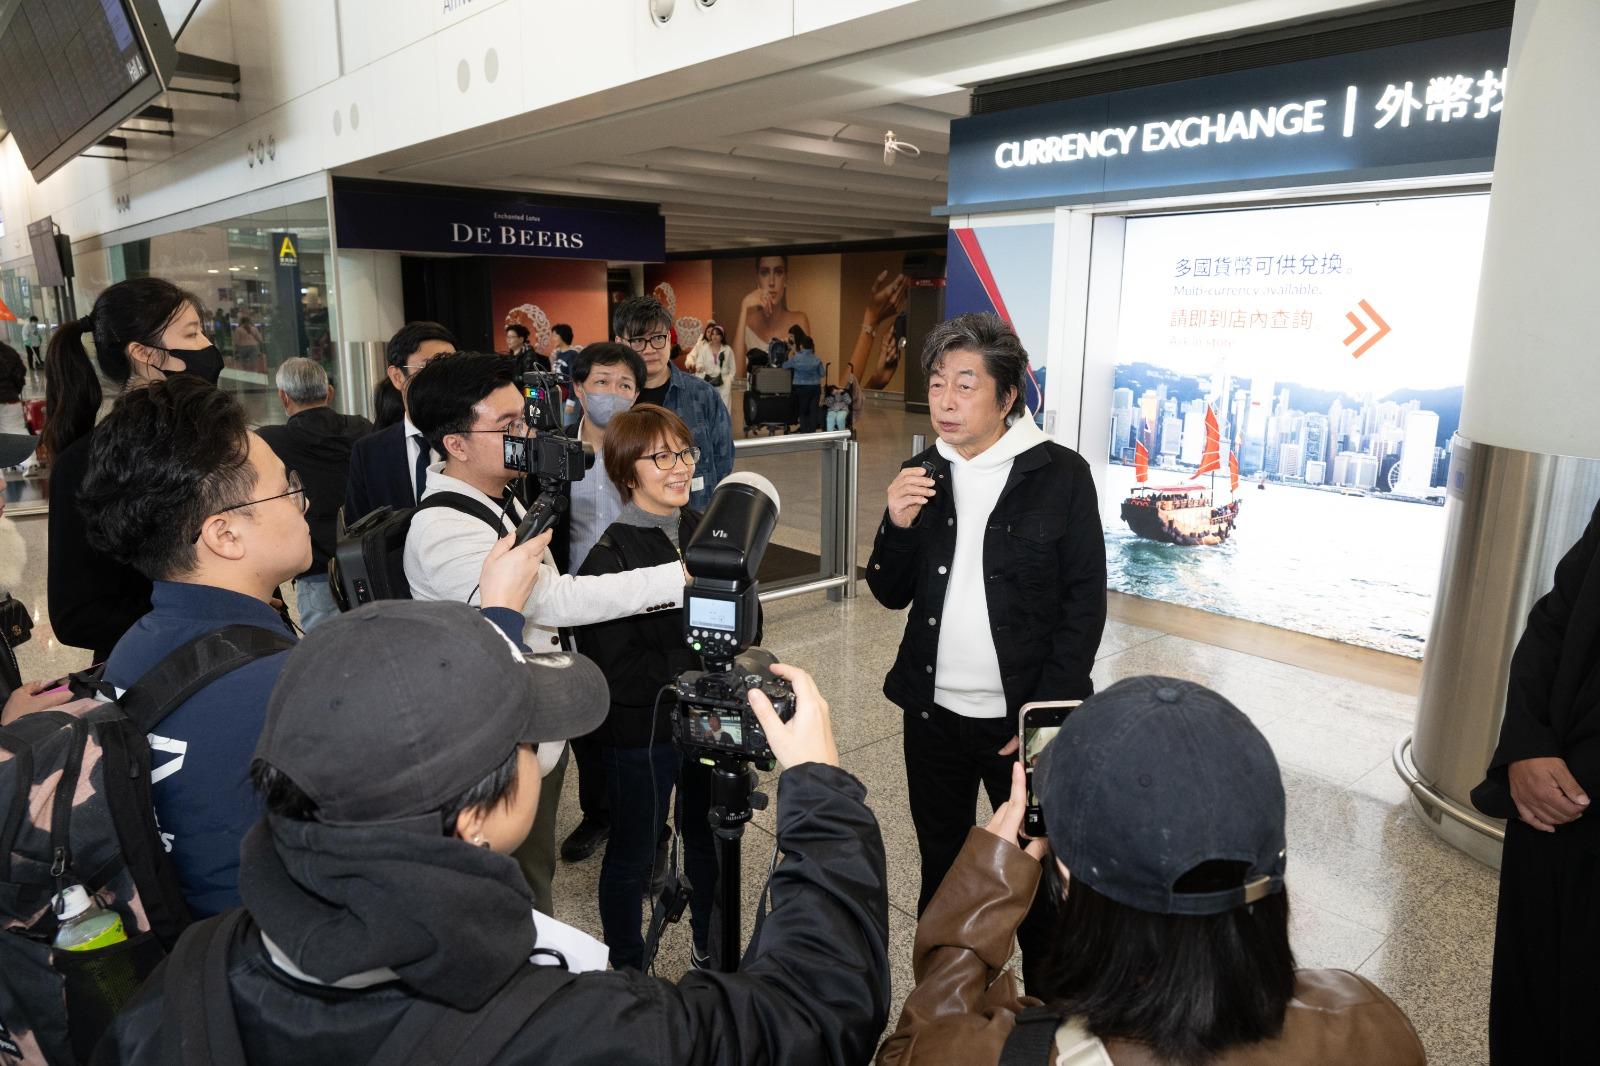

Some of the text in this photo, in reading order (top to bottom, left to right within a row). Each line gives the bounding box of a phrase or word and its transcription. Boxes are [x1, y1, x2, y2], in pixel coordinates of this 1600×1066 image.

[994, 98, 1328, 169] CURRENCY EXCHANGE
[279, 235, 298, 257] A
[450, 222, 584, 249] DE BEERS
